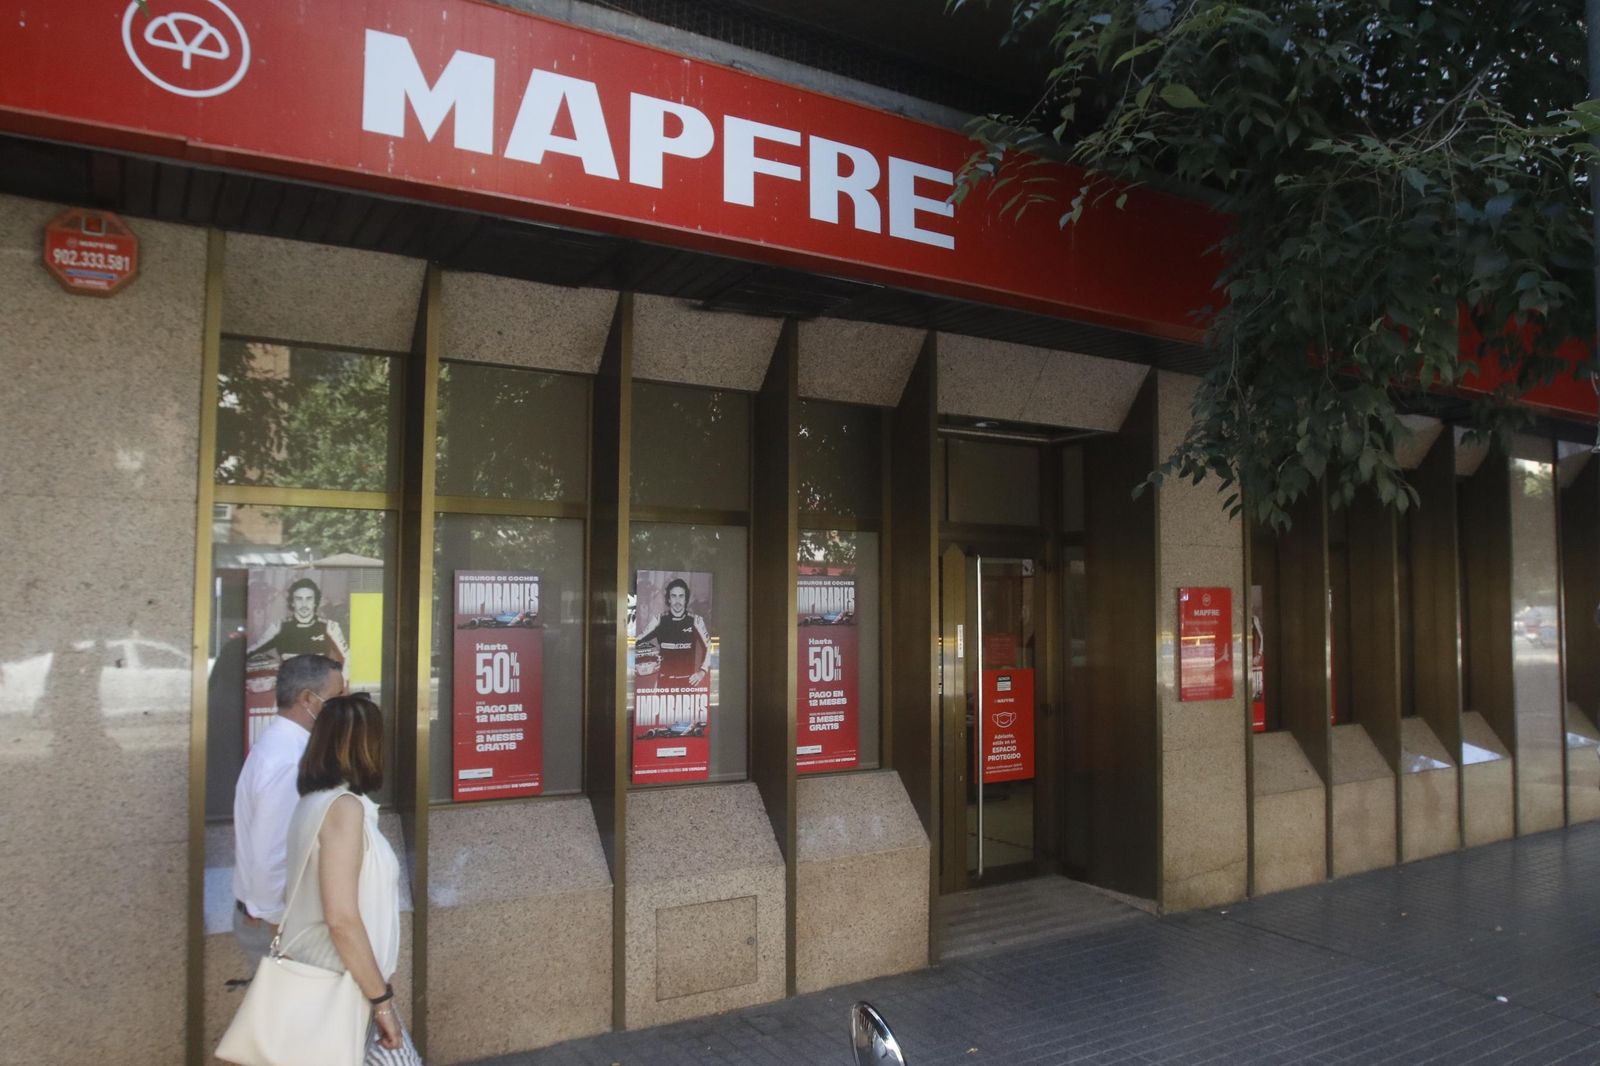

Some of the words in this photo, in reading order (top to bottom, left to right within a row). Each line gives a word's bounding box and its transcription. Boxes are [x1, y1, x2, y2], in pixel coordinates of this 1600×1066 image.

[362, 28, 955, 250] MAPFRE
[459, 583, 539, 615] IMPARABLES
[476, 643, 508, 651] Hasta
[808, 646, 841, 682] 50%
[476, 651, 520, 694] 50%
[809, 691, 832, 699] PAGO
[819, 698, 847, 706] MESES
[476, 705, 507, 713] PAGO
[508, 704, 523, 712] EN
[476, 715, 488, 723] 12
[490, 713, 528, 722] MESES
[816, 715, 845, 723] MESES
[809, 723, 840, 731] GRATIS
[486, 733, 524, 742] MESES
[476, 742, 517, 752] GRATIS
[988, 753, 1021, 762] PROTEGIDO
